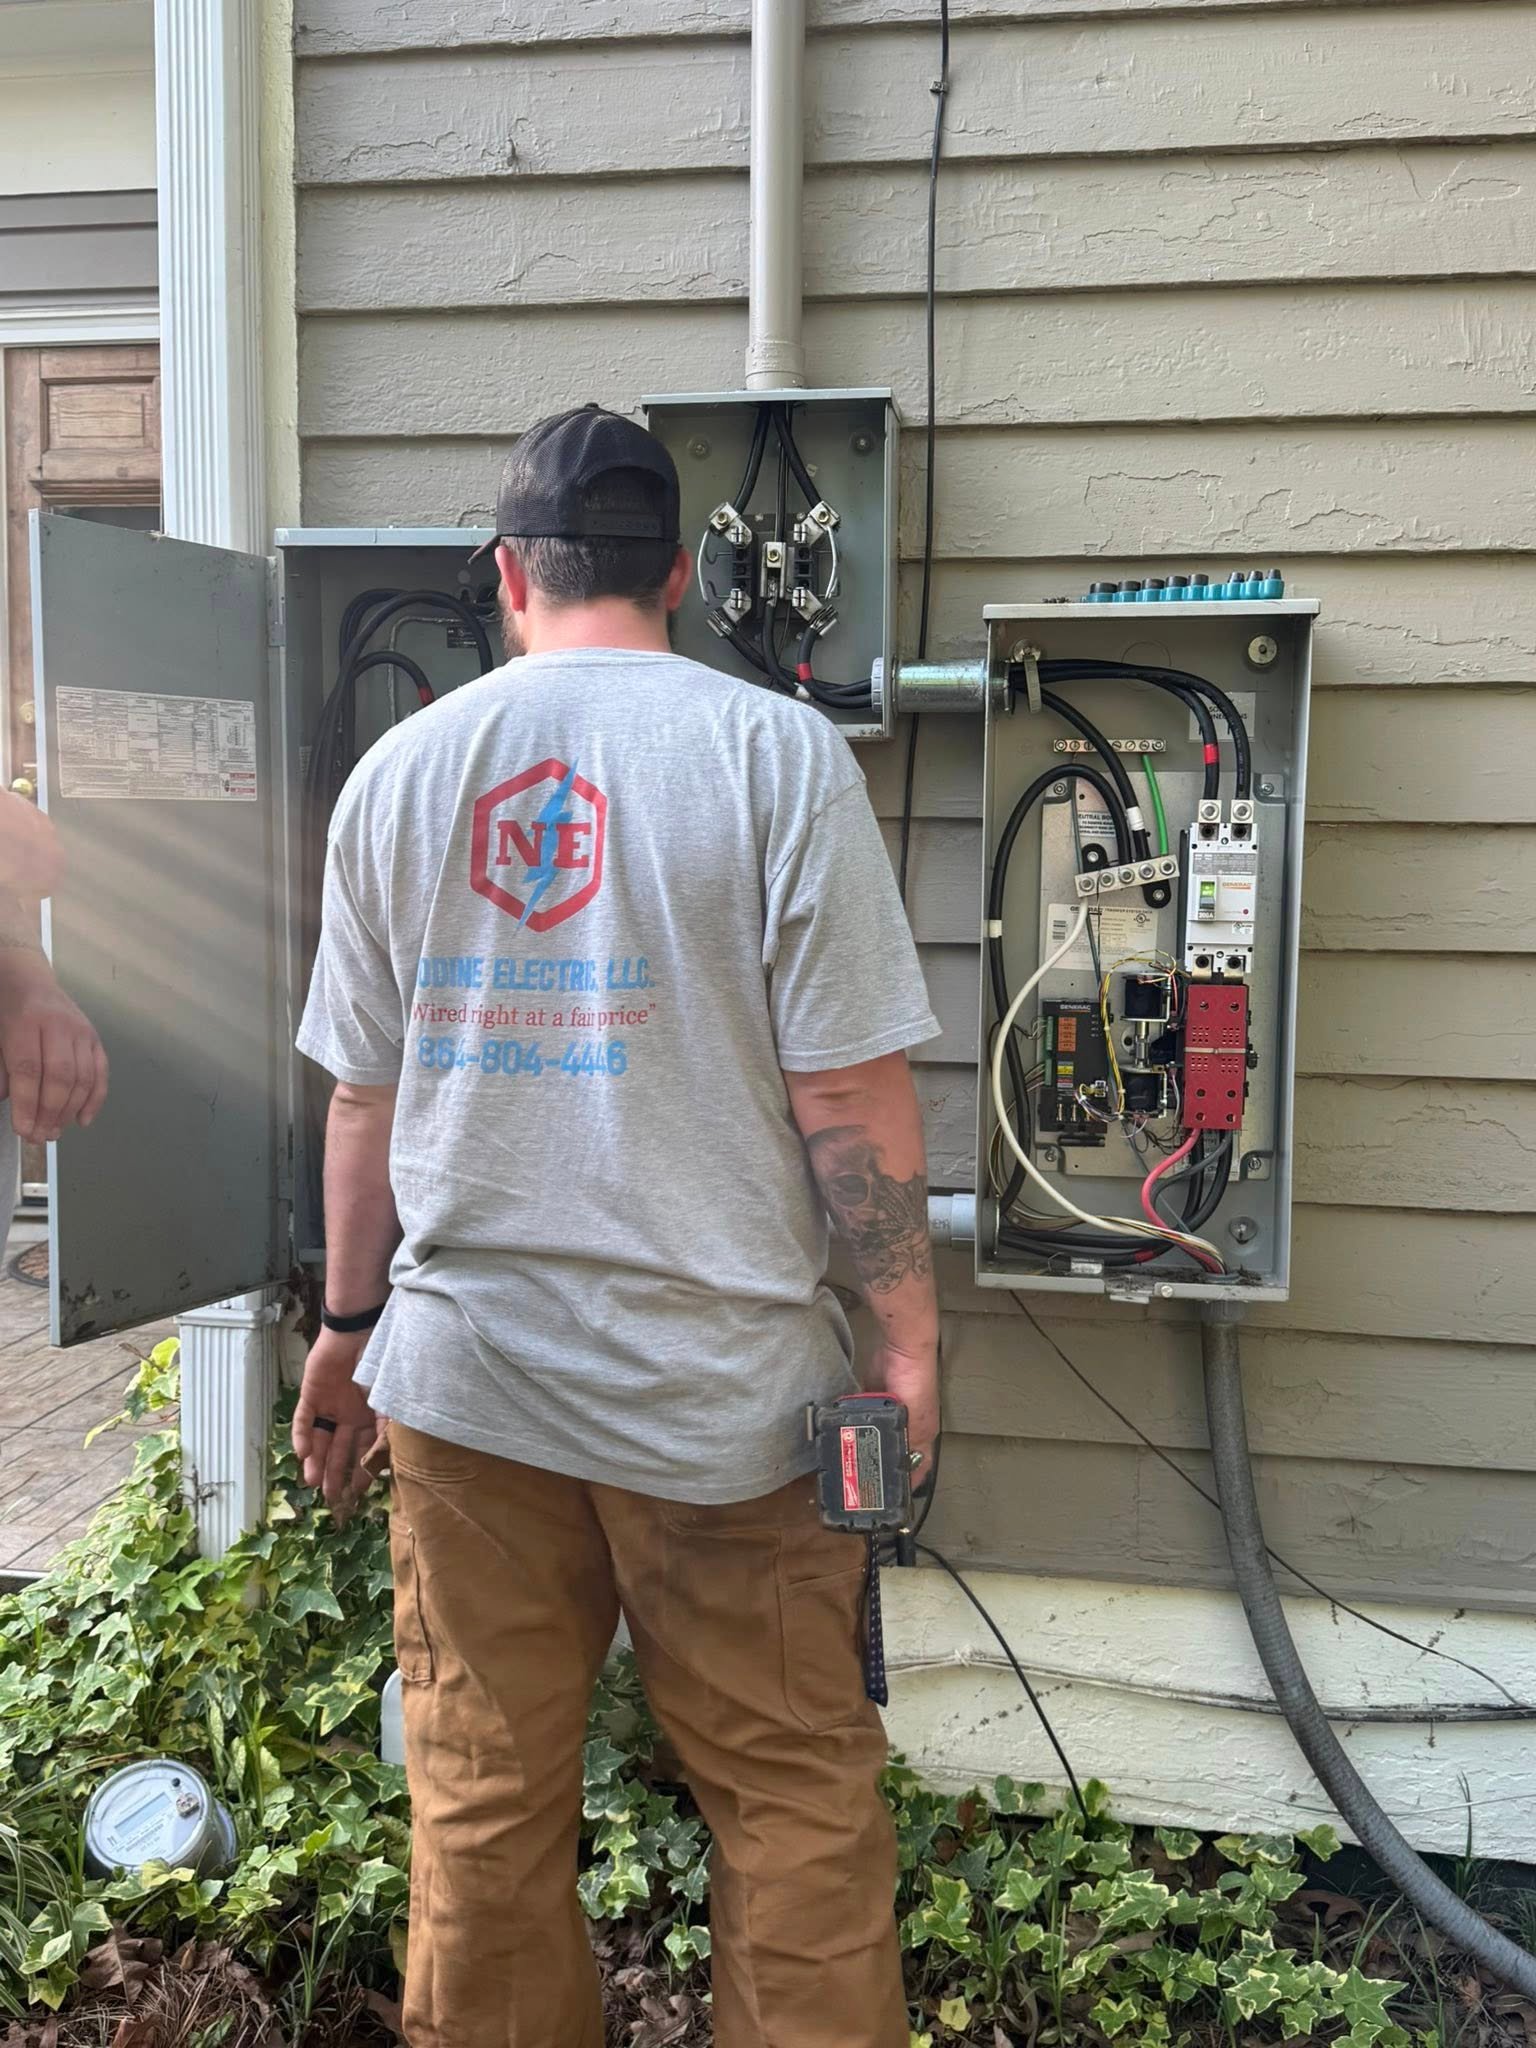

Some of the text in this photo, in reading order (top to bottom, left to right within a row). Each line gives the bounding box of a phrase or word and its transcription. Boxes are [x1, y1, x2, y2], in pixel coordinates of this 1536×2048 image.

[471, 1003, 519, 1030] right
[525, 1007, 546, 1027] at
[551, 1011, 564, 1027] a
[570, 1006, 594, 1027] fair
